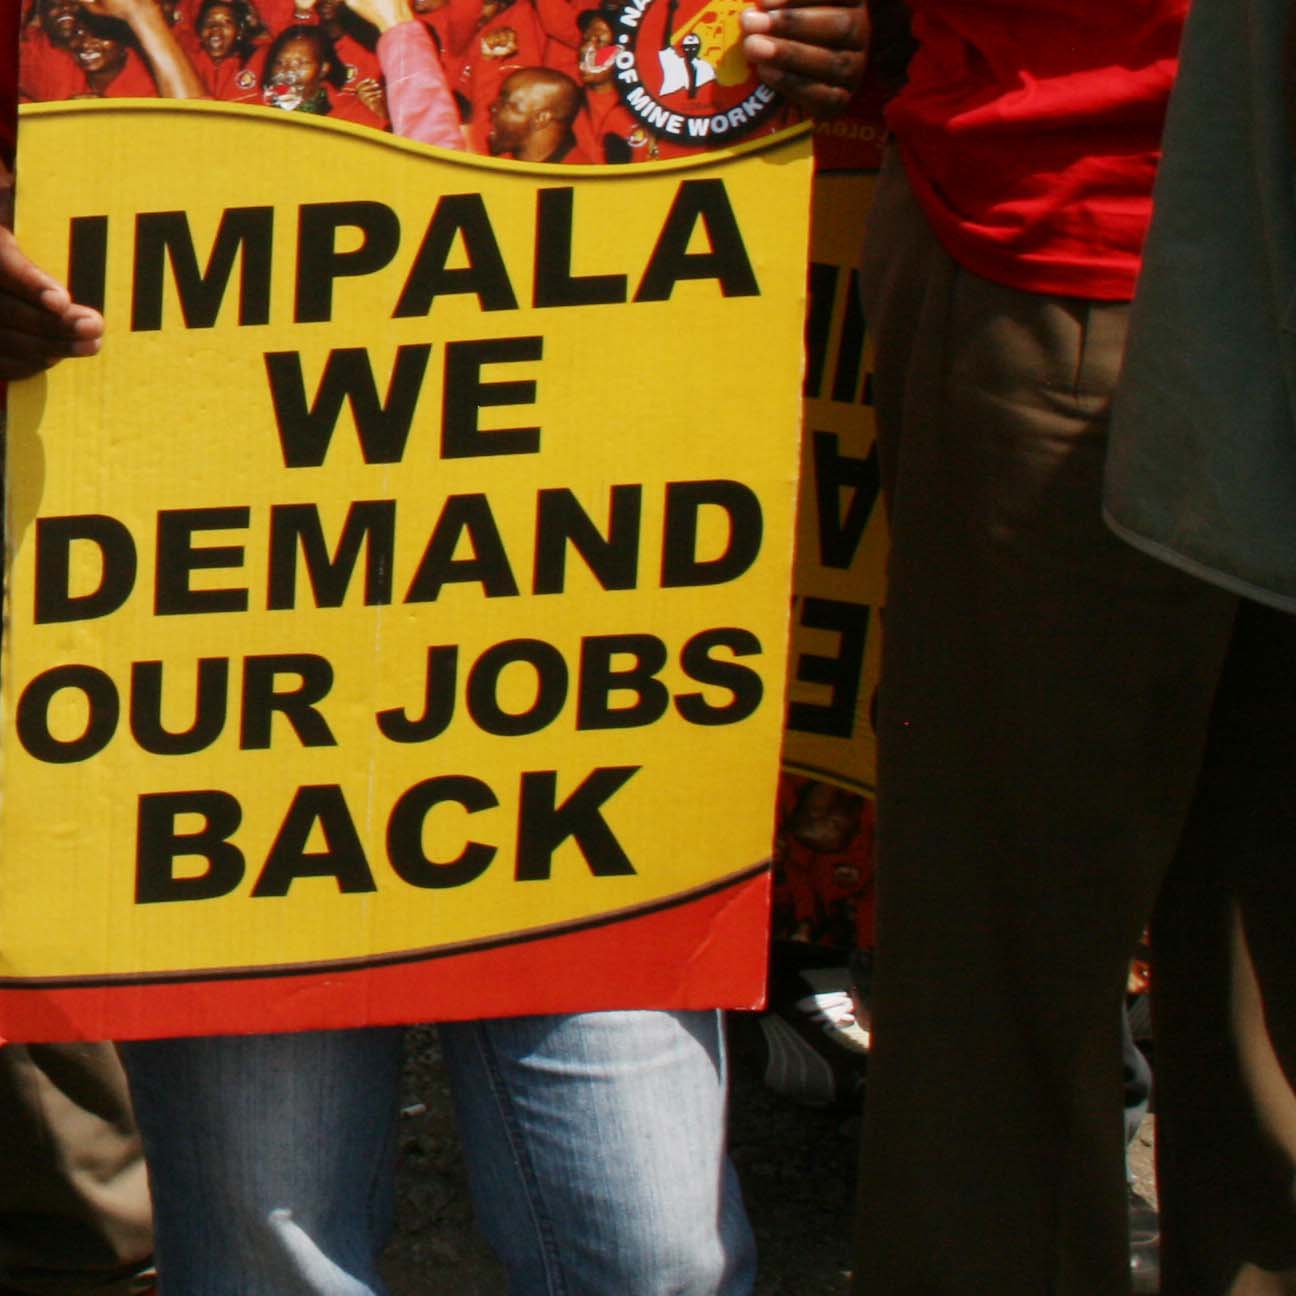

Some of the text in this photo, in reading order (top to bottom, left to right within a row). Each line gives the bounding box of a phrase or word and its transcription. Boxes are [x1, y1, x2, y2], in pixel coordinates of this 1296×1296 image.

[616, 51, 775, 137] OF MINE WORKE
[66, 177, 761, 333] IMPALA
[263, 335, 544, 468] WE
[33, 478, 765, 624] DEMAND
[15, 652, 338, 765] OUR
[375, 627, 766, 745] JOBS
[133, 765, 643, 904] BACK
